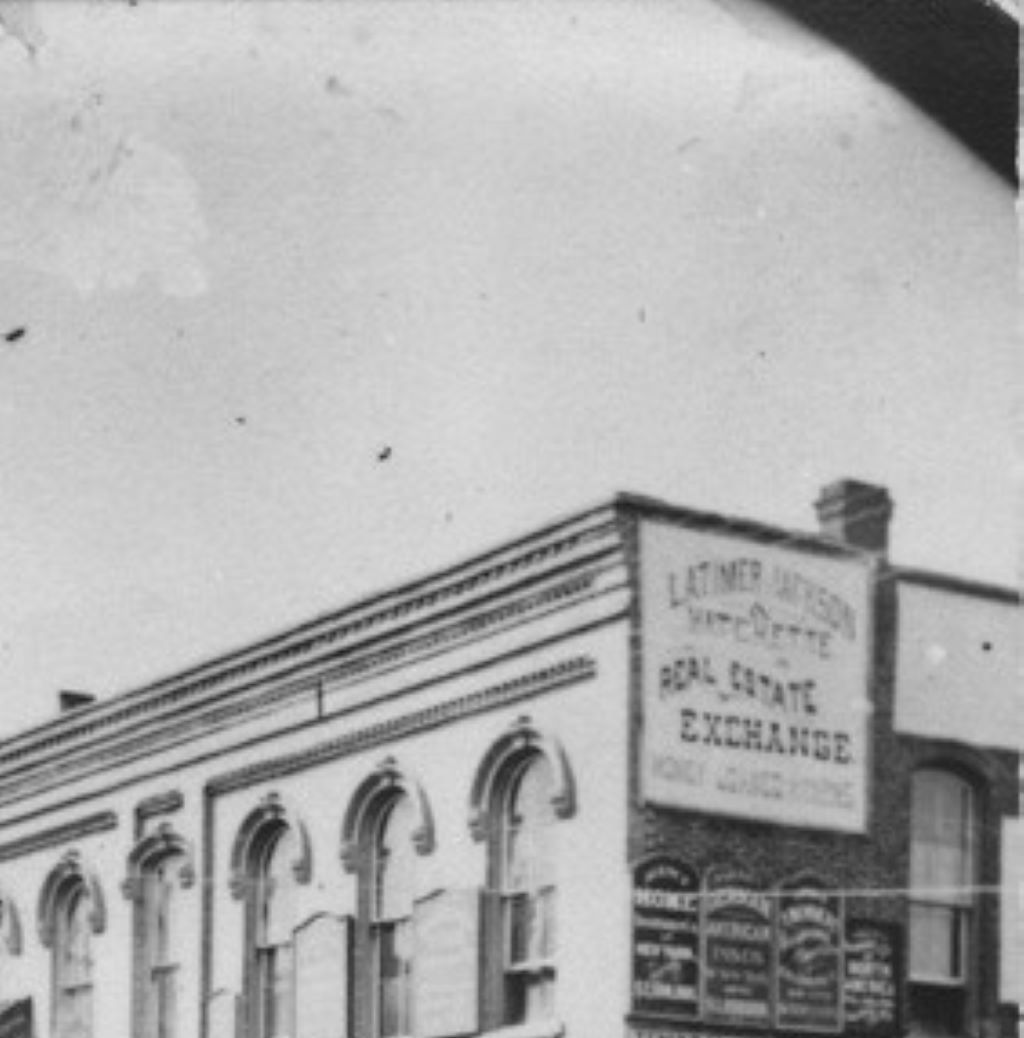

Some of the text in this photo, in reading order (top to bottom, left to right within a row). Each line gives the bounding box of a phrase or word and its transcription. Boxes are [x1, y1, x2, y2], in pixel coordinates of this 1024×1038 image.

[659, 654, 818, 716] REAL ESTATE
[679, 706, 854, 766] EXCHANGE
